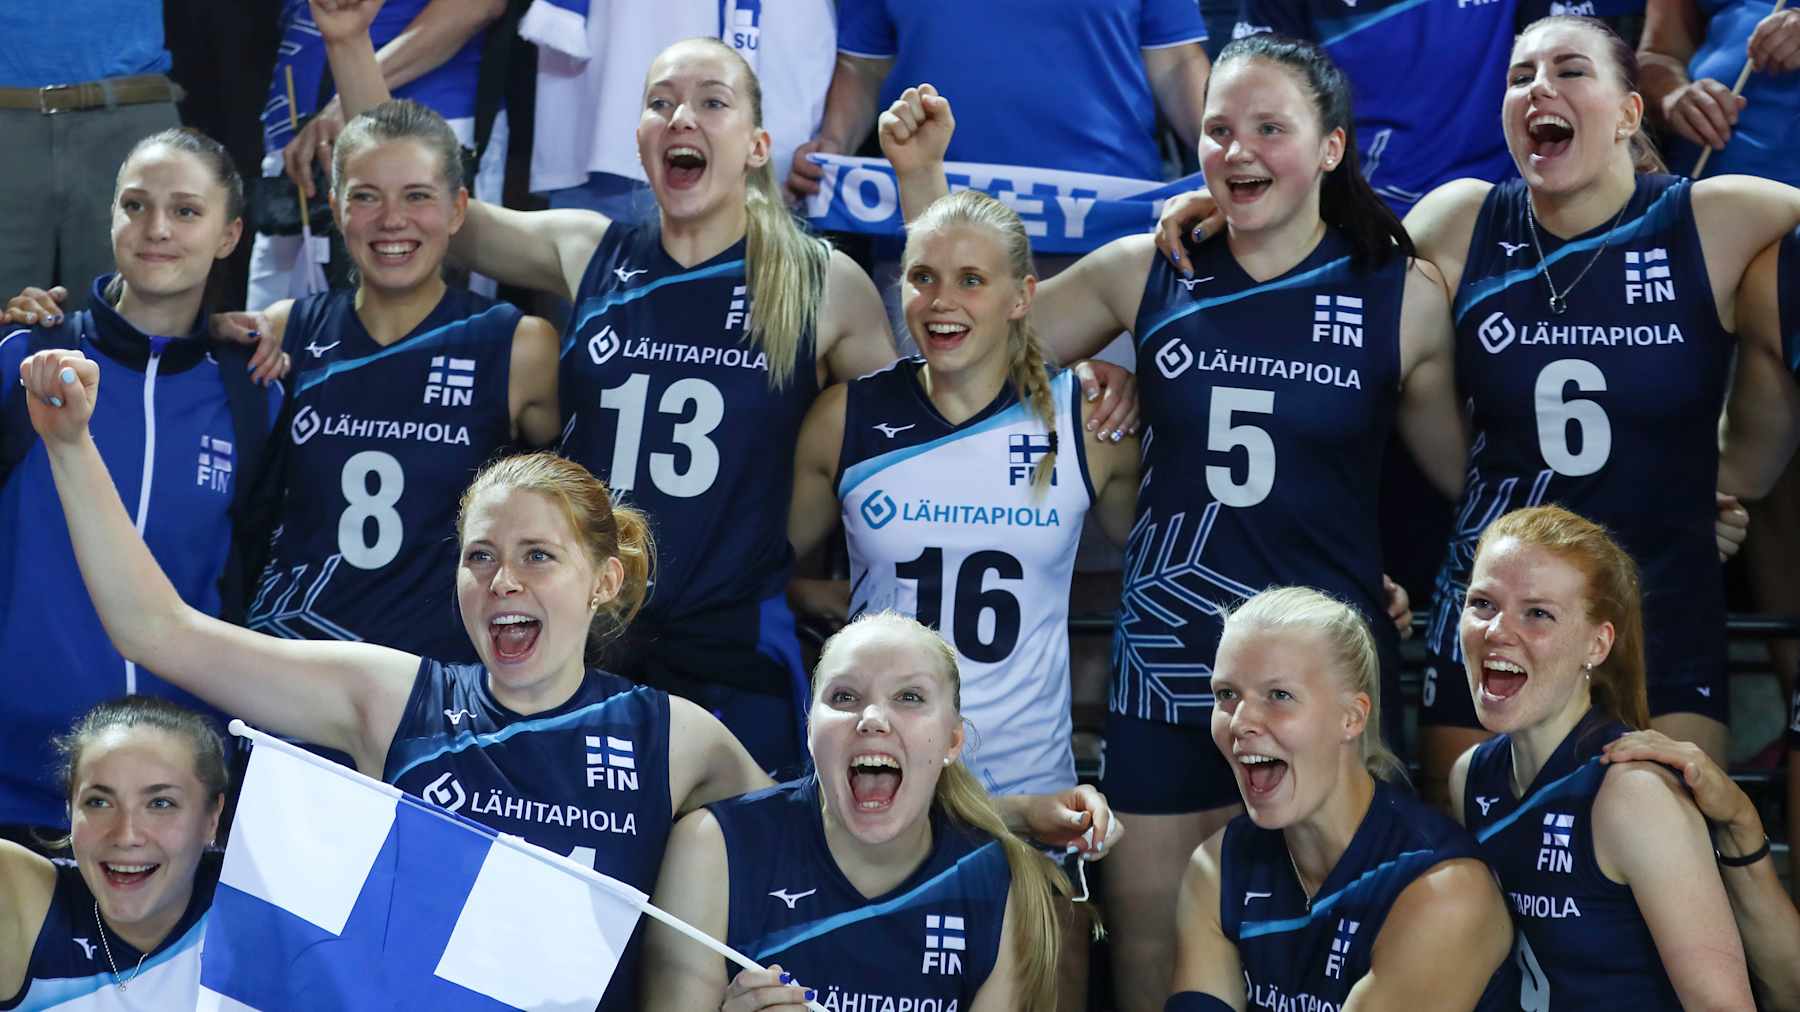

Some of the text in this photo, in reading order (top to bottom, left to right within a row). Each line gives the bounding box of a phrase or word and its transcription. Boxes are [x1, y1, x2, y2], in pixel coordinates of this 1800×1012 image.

[806, 163, 1097, 239] VOEY
[1625, 280, 1676, 304] FIN
[724, 311, 760, 332] FI
[1312, 324, 1363, 347] FIN
[1520, 321, 1685, 346] LÄHITAPIOLA
[622, 337, 769, 371] LÄHITAPIOLA
[1198, 349, 1362, 390] LÄHITAPIOLA
[423, 385, 473, 406] FIN
[322, 414, 471, 446] LÄHITAPIOLA
[1534, 358, 1612, 477] 6
[600, 372, 725, 498] 13
[1205, 386, 1276, 507] 5
[197, 465, 231, 494] FIN
[338, 451, 405, 570] 8
[903, 499, 1060, 527] LÄHITAPIOLA
[895, 546, 1024, 664] 16
[1423, 666, 1438, 707] 6
[586, 766, 639, 791] FIN
[471, 789, 637, 836] LÄHITAPIOLA
[1537, 847, 1573, 874] FIN
